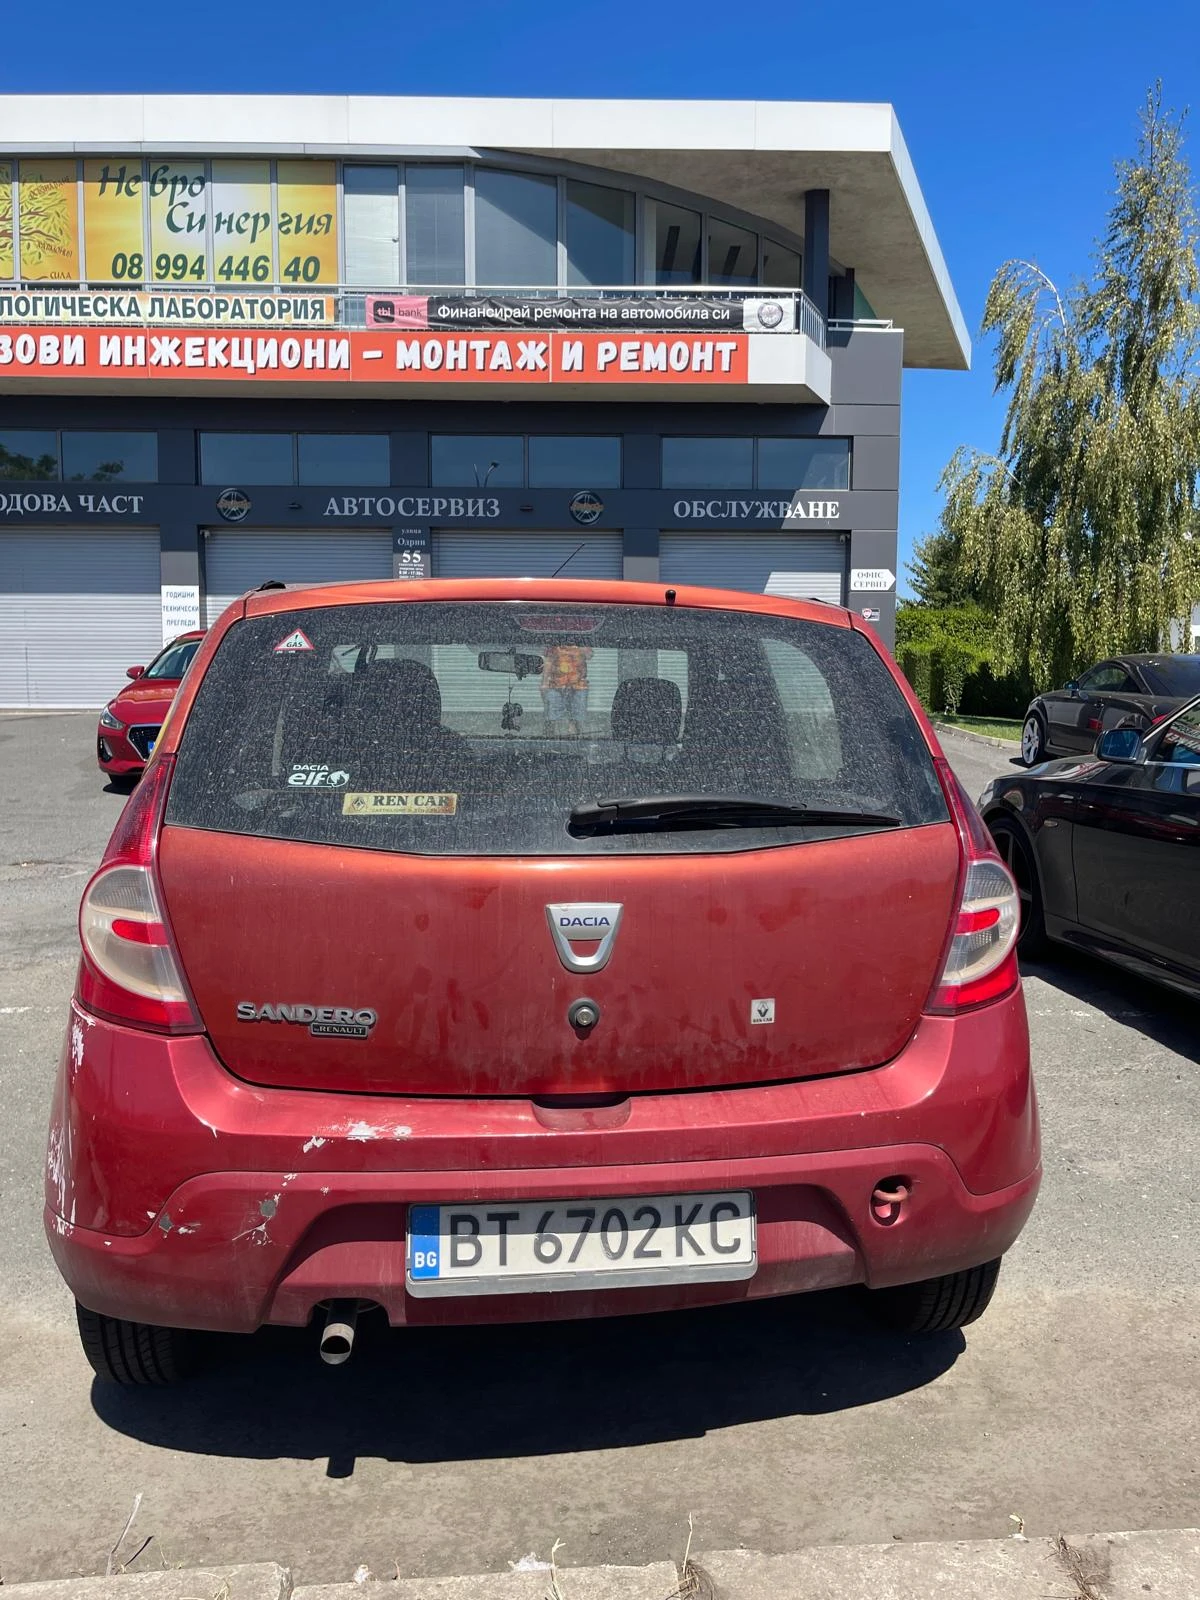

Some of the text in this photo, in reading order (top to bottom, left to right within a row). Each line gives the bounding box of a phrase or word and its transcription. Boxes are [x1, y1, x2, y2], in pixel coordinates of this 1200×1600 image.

[98, 165, 206, 206] Невро
[166, 201, 332, 244] Синергия
[111, 253, 321, 283] 08 994 446 40
[0, 296, 325, 320] ЛОГИЧЕСКА ЛАБОРАТОРИЯ
[377, 307, 422, 318] tbi bank
[437, 304, 730, 321] Финансирай ремонта на автомобила си
[99, 334, 350, 374] ИНЖЕКЦИОНИ
[396, 339, 549, 373] МОНТАЖ
[561, 341, 580, 373] И
[597, 341, 738, 373] РЕМОНТ
[78, 494, 144, 514] ЧАСТ
[323, 497, 500, 518] АВТОСЕРВИЗ
[673, 500, 840, 520] ОБСЛУЖВАНЕ
[402, 549, 421, 563] 55
[857, 571, 884, 579] ОФИС
[166, 591, 195, 599] ГОДИШНИ
[166, 619, 196, 627] ПРЕГЛЕДИ
[287, 771, 328, 786] elf
[372, 795, 449, 807] REN CAR
[560, 917, 611, 927] DACIA
[237, 1001, 377, 1026] SANDERO
[320, 1026, 363, 1034] RENAULT
[533, 1206, 662, 1264] 6702
[414, 1252, 437, 1269] BG
